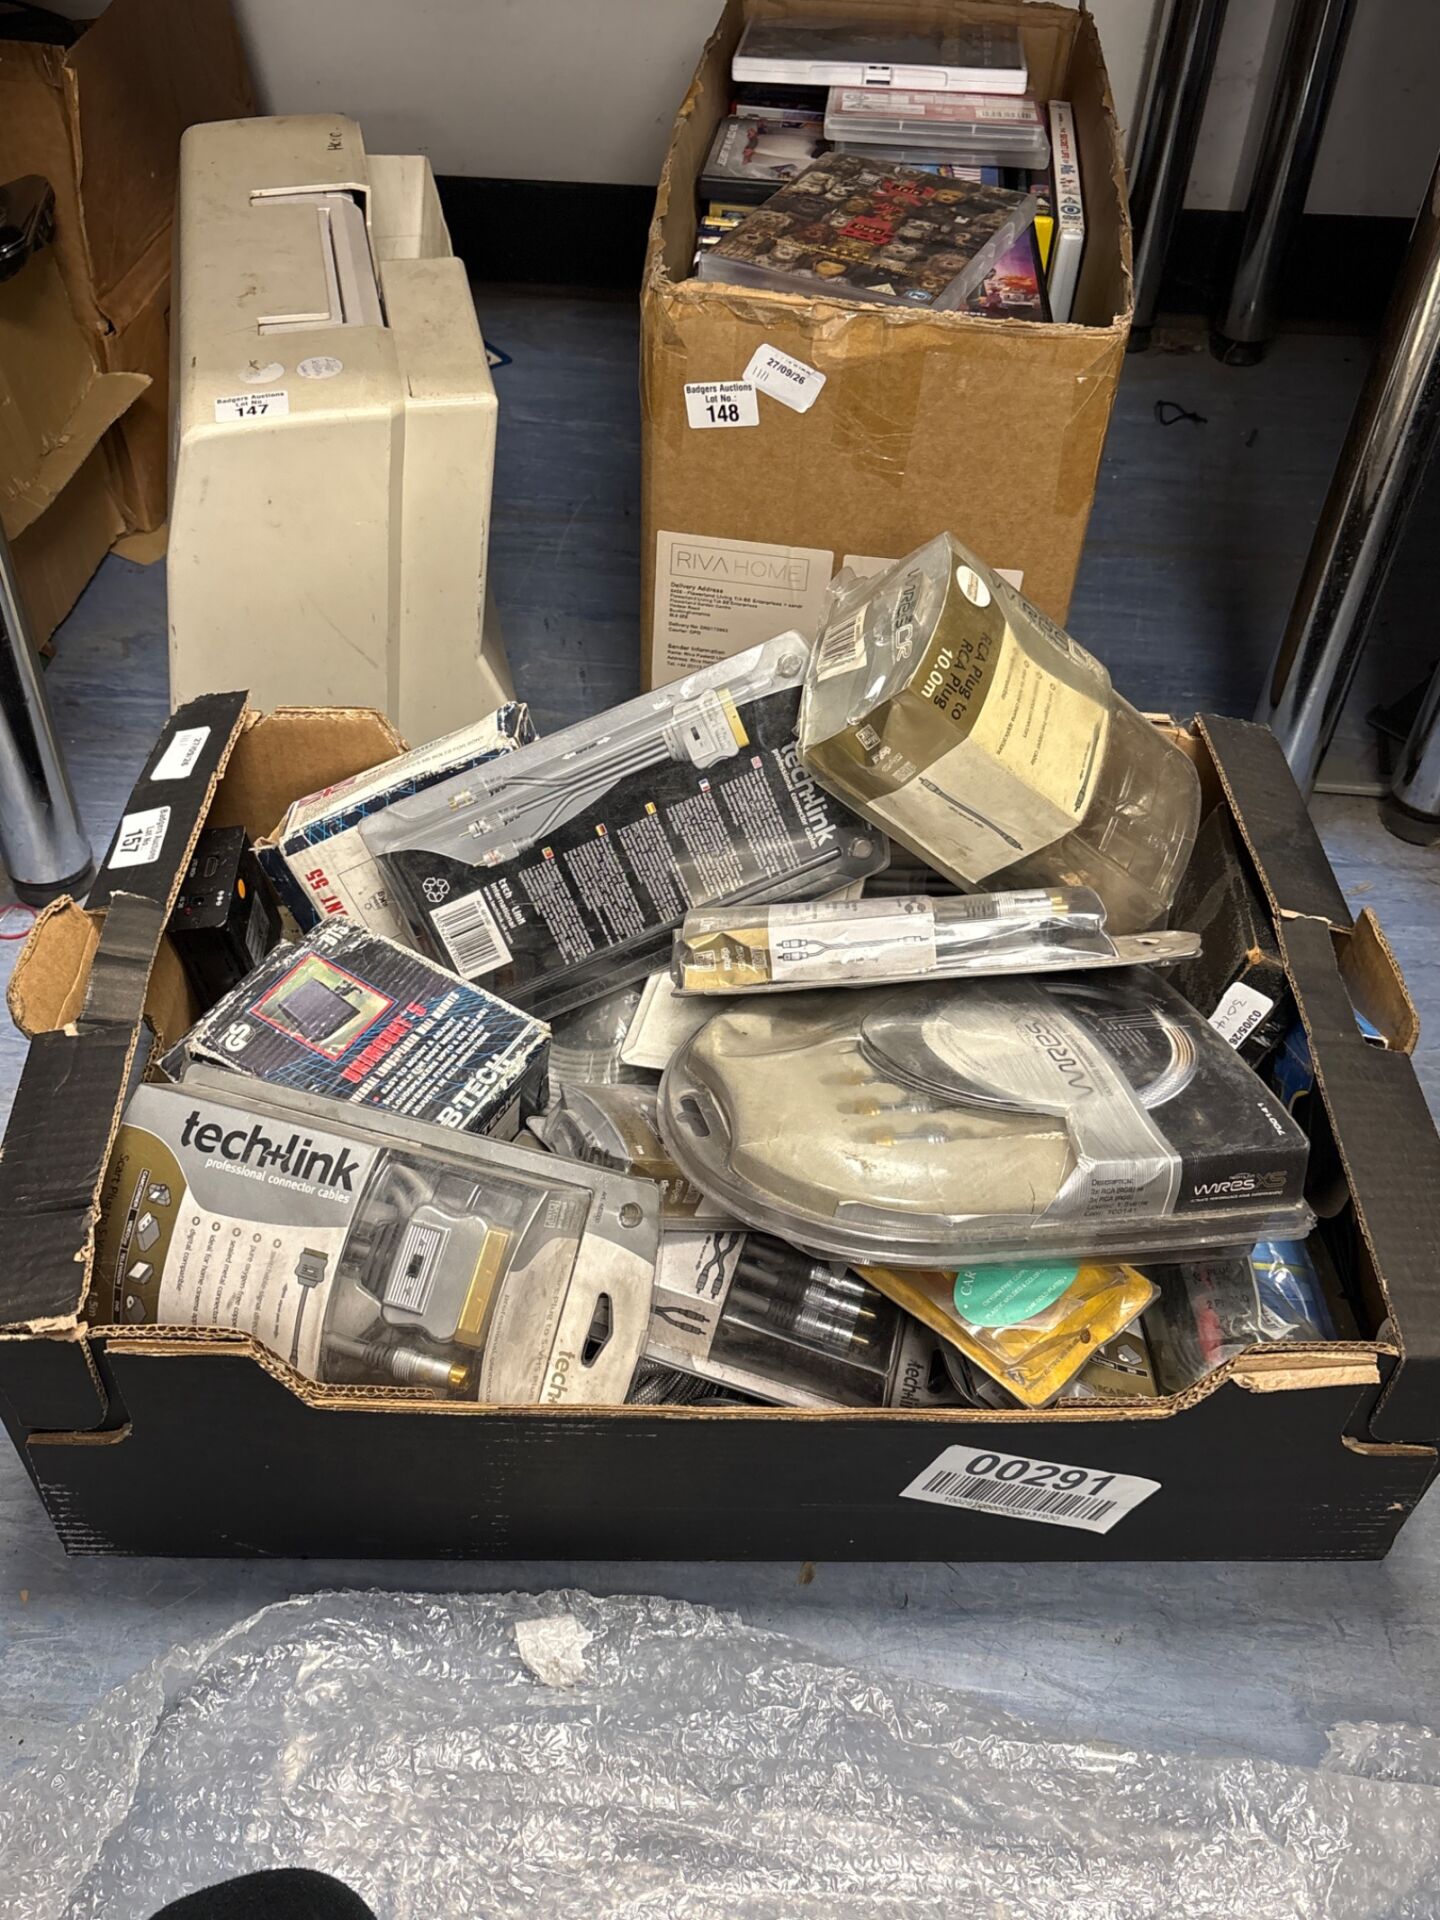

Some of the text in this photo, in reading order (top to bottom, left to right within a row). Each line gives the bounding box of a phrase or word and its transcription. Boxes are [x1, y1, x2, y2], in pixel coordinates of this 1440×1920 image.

[686, 383, 752, 395] Badgers Auctions
[767, 358, 806, 385] 27/09/26
[235, 404, 269, 417] 147
[705, 395, 718, 403] Lot
[706, 404, 739, 422] 148
[734, 559, 802, 582] HOME
[921, 647, 953, 698] 10.0m
[934, 639, 973, 710] RCA Plug
[952, 632, 992, 720] RCA Plug to
[771, 748, 818, 850] professional connector cables
[120, 828, 143, 852] 157
[415, 1019, 437, 1035] WALL
[1229, 1010, 1261, 1046] 03/05/26
[341, 1015, 413, 1084] UNIMOUNT
[381, 1077, 398, 1094] EASY
[406, 1044, 429, 1067] MOUNT
[433, 1016, 456, 1040] ADJUST
[401, 1025, 485, 1113] UNIVERSAL FIXINGS INCLUDED
[382, 1071, 413, 1105] SUITABLE
[411, 1061, 425, 1074] FOR
[424, 1042, 444, 1062] MOST
[392, 1061, 440, 1109] LOUDSPEAKERS
[412, 1086, 440, 1116] ADJUSTS
[445, 1067, 459, 1079] ALL
[456, 1032, 491, 1067] DIRECTIONS
[1257, 1102, 1286, 1136] 700141
[112, 1153, 129, 1183] Scart
[205, 1157, 351, 1205] professional connector cables
[965, 1454, 1116, 1496] 00291
